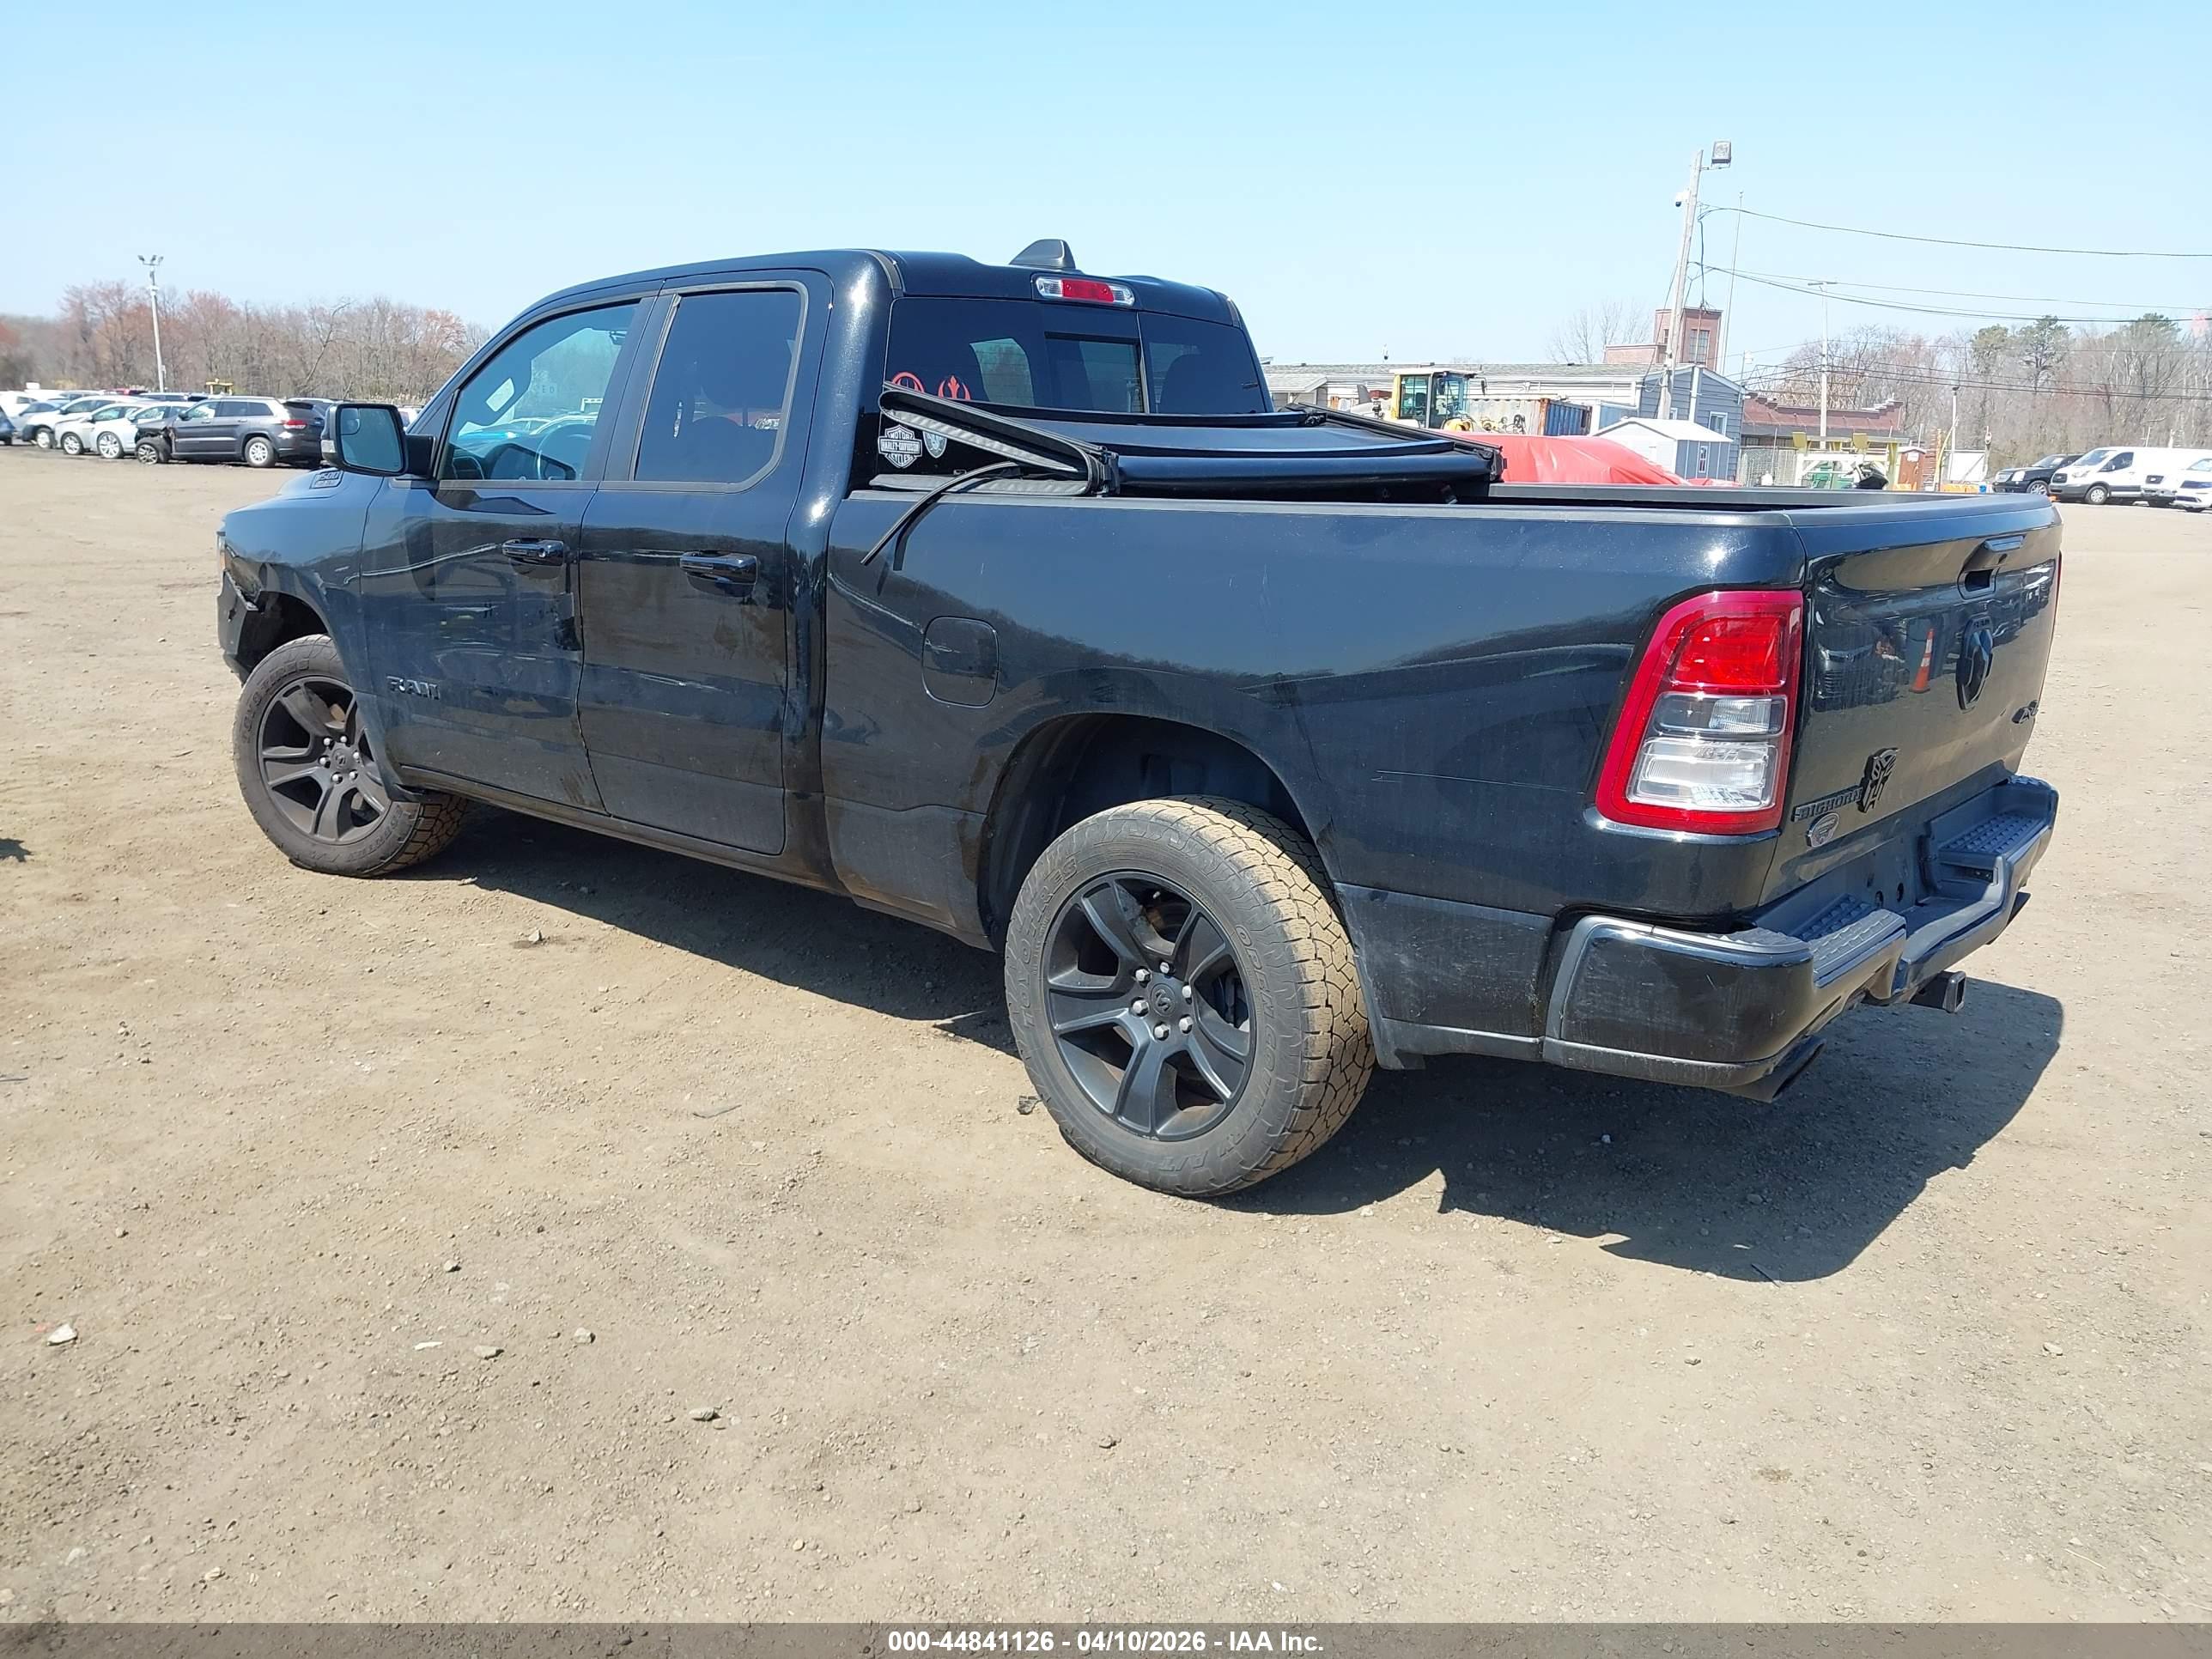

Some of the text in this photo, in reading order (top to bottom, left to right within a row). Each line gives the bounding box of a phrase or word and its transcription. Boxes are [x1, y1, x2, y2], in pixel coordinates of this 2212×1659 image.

[889, 431, 910, 440] MOTOR
[881, 441, 920, 453] HARLEY-DAVIDSON
[890, 453, 912, 465] CYCLES
[386, 675, 441, 700] RAM
[1235, 924, 1275, 1019] OPEN
